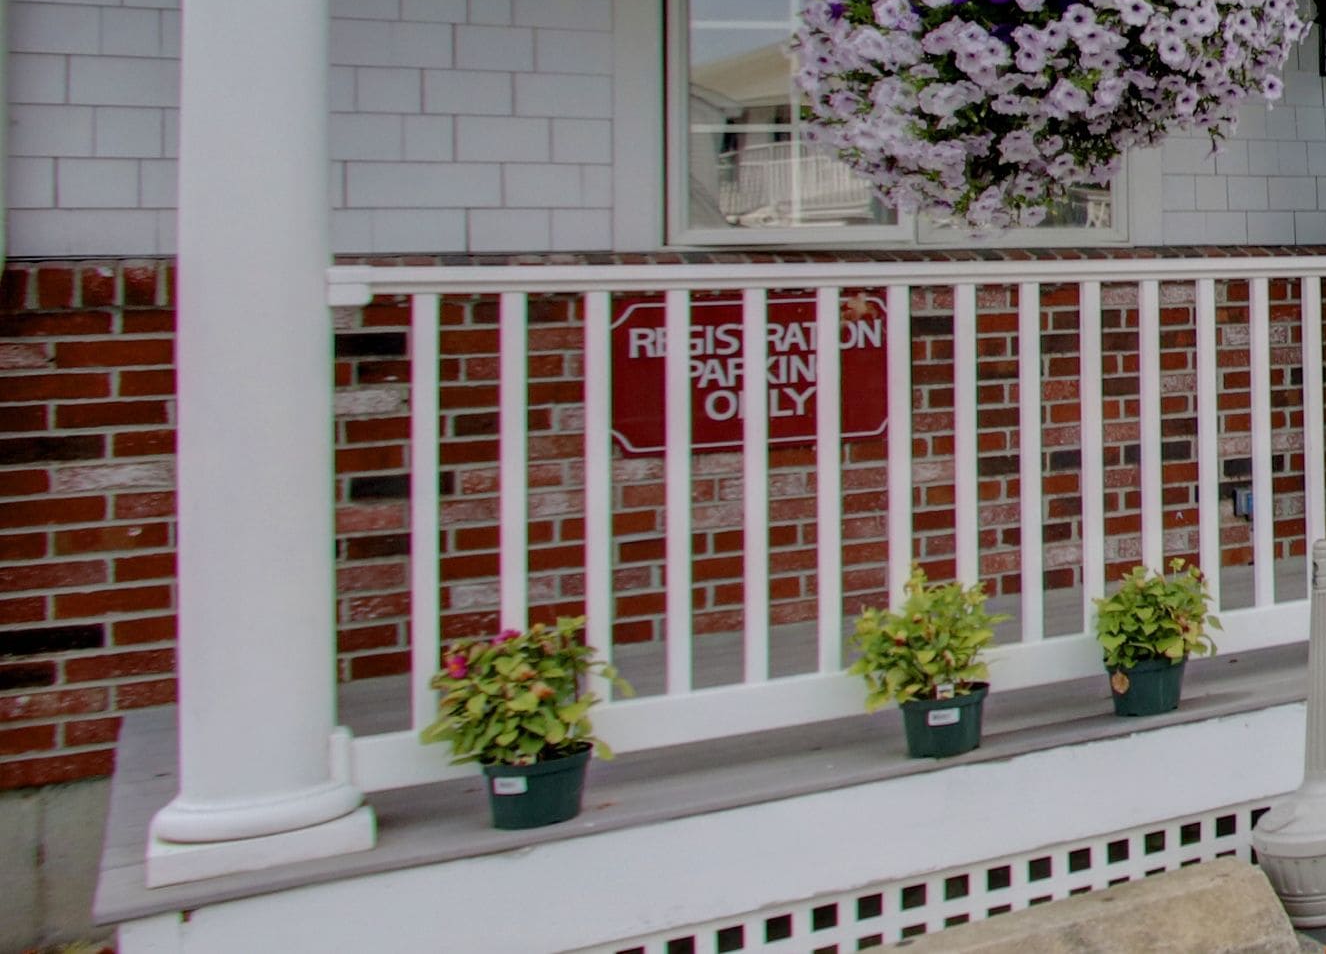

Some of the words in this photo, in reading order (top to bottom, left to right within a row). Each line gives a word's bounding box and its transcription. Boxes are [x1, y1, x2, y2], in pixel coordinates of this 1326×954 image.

[628, 318, 882, 359] REGISRATON
[687, 354, 822, 389] PARKIN
[704, 386, 817, 421] OLY
